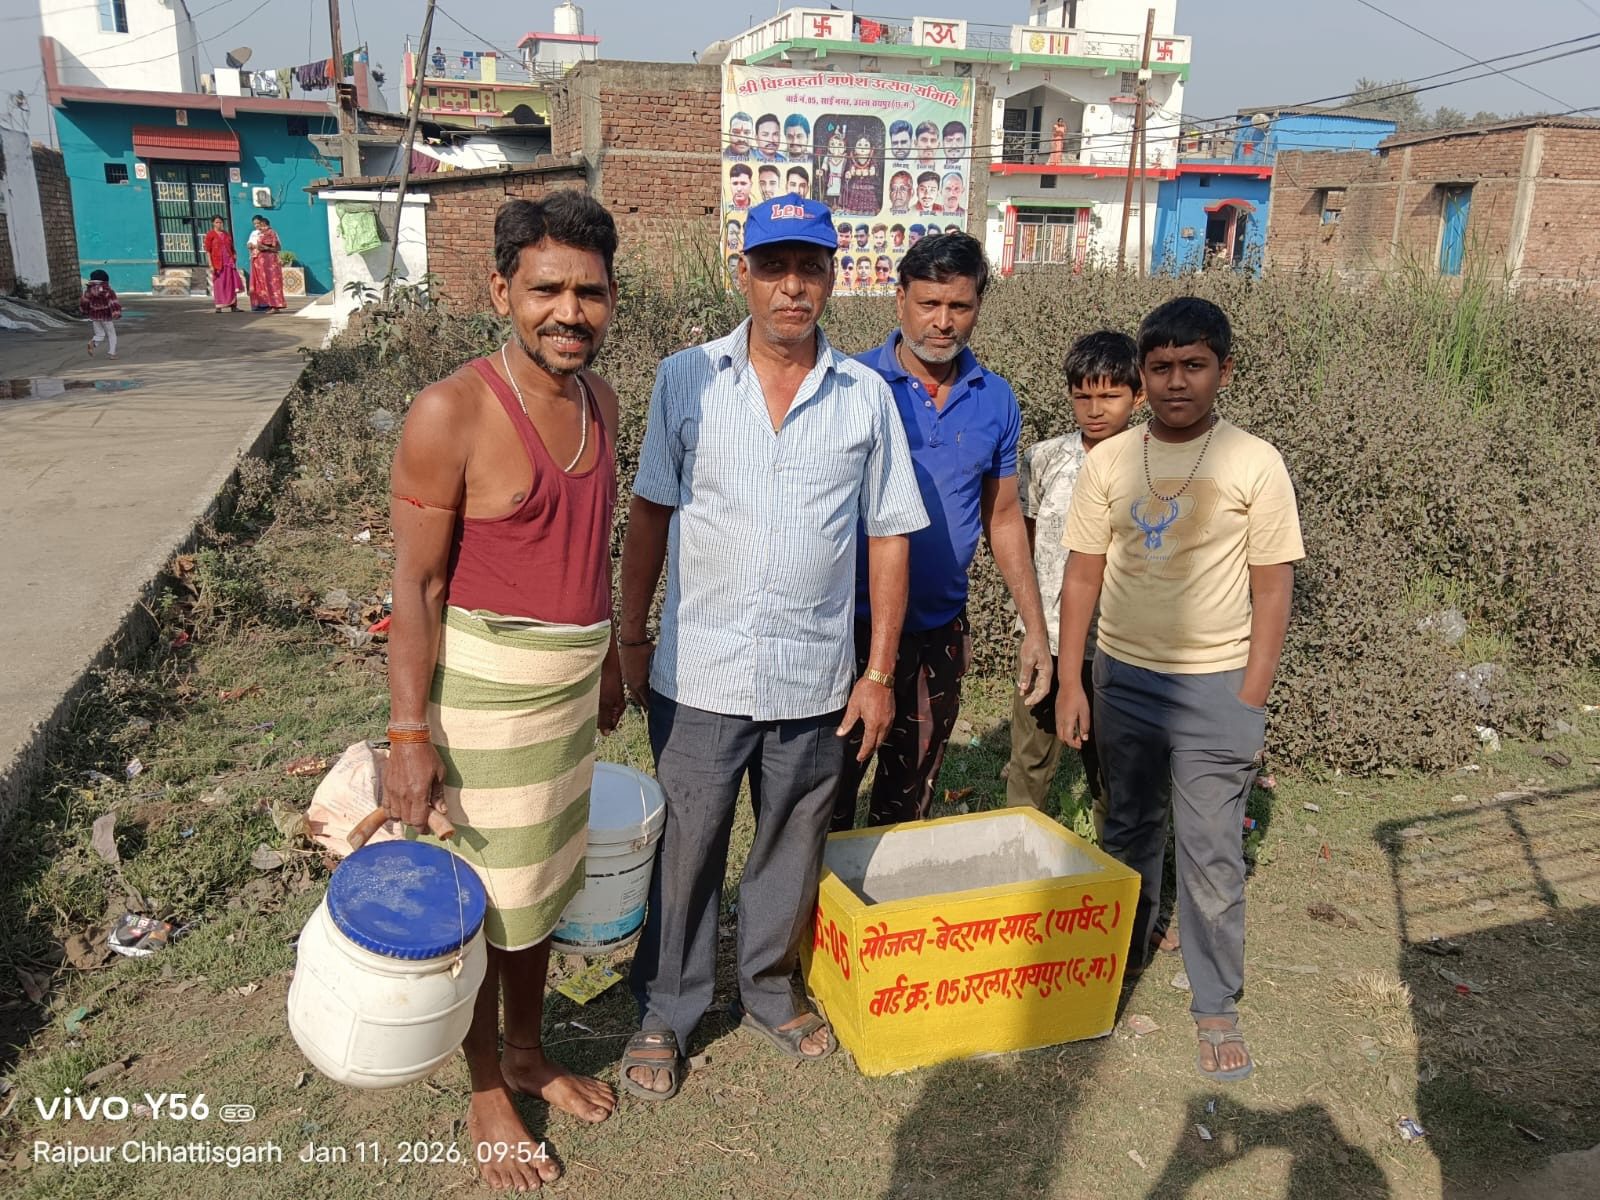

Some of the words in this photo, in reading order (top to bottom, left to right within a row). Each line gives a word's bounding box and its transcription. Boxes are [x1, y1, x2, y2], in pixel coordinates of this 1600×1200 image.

[738, 78, 758, 95] श्री
[827, 74, 868, 88] गणेश
[871, 78, 911, 93] उत्सव
[913, 84, 959, 108] समिति
[998, 912, 1044, 945] साहू
[868, 973, 909, 1018] वार्ड
